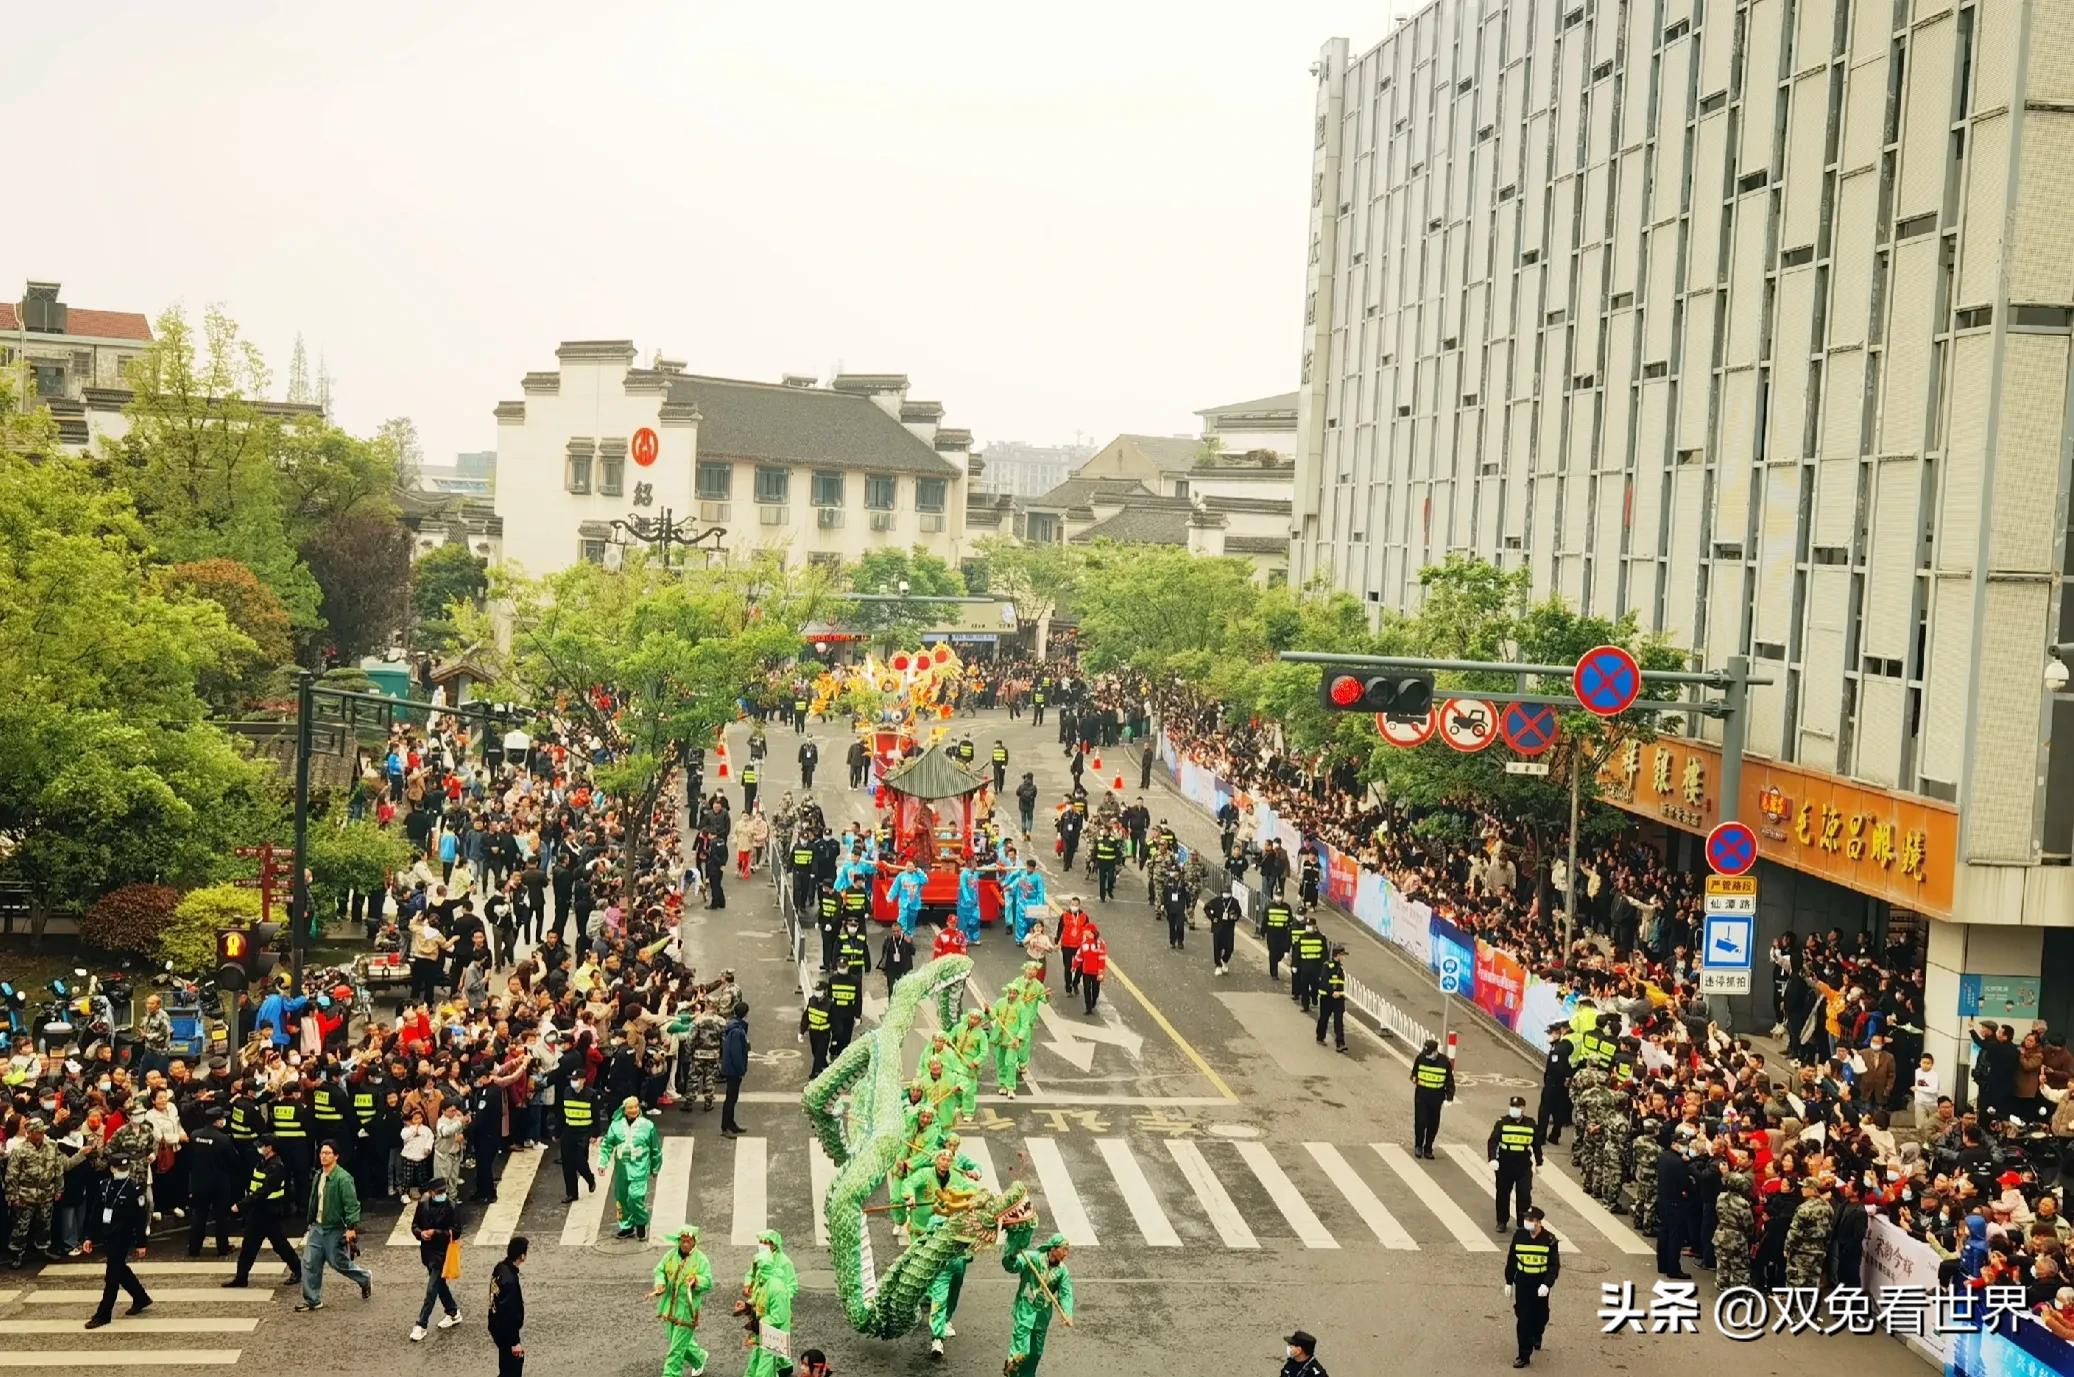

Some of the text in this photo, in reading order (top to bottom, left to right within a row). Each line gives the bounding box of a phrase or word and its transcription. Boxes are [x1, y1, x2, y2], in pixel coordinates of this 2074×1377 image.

[1710, 879, 1752, 891] 严管路段
[1710, 898, 1750, 909] 仙潭路
[1704, 976, 1746, 988] 违停抓拍
